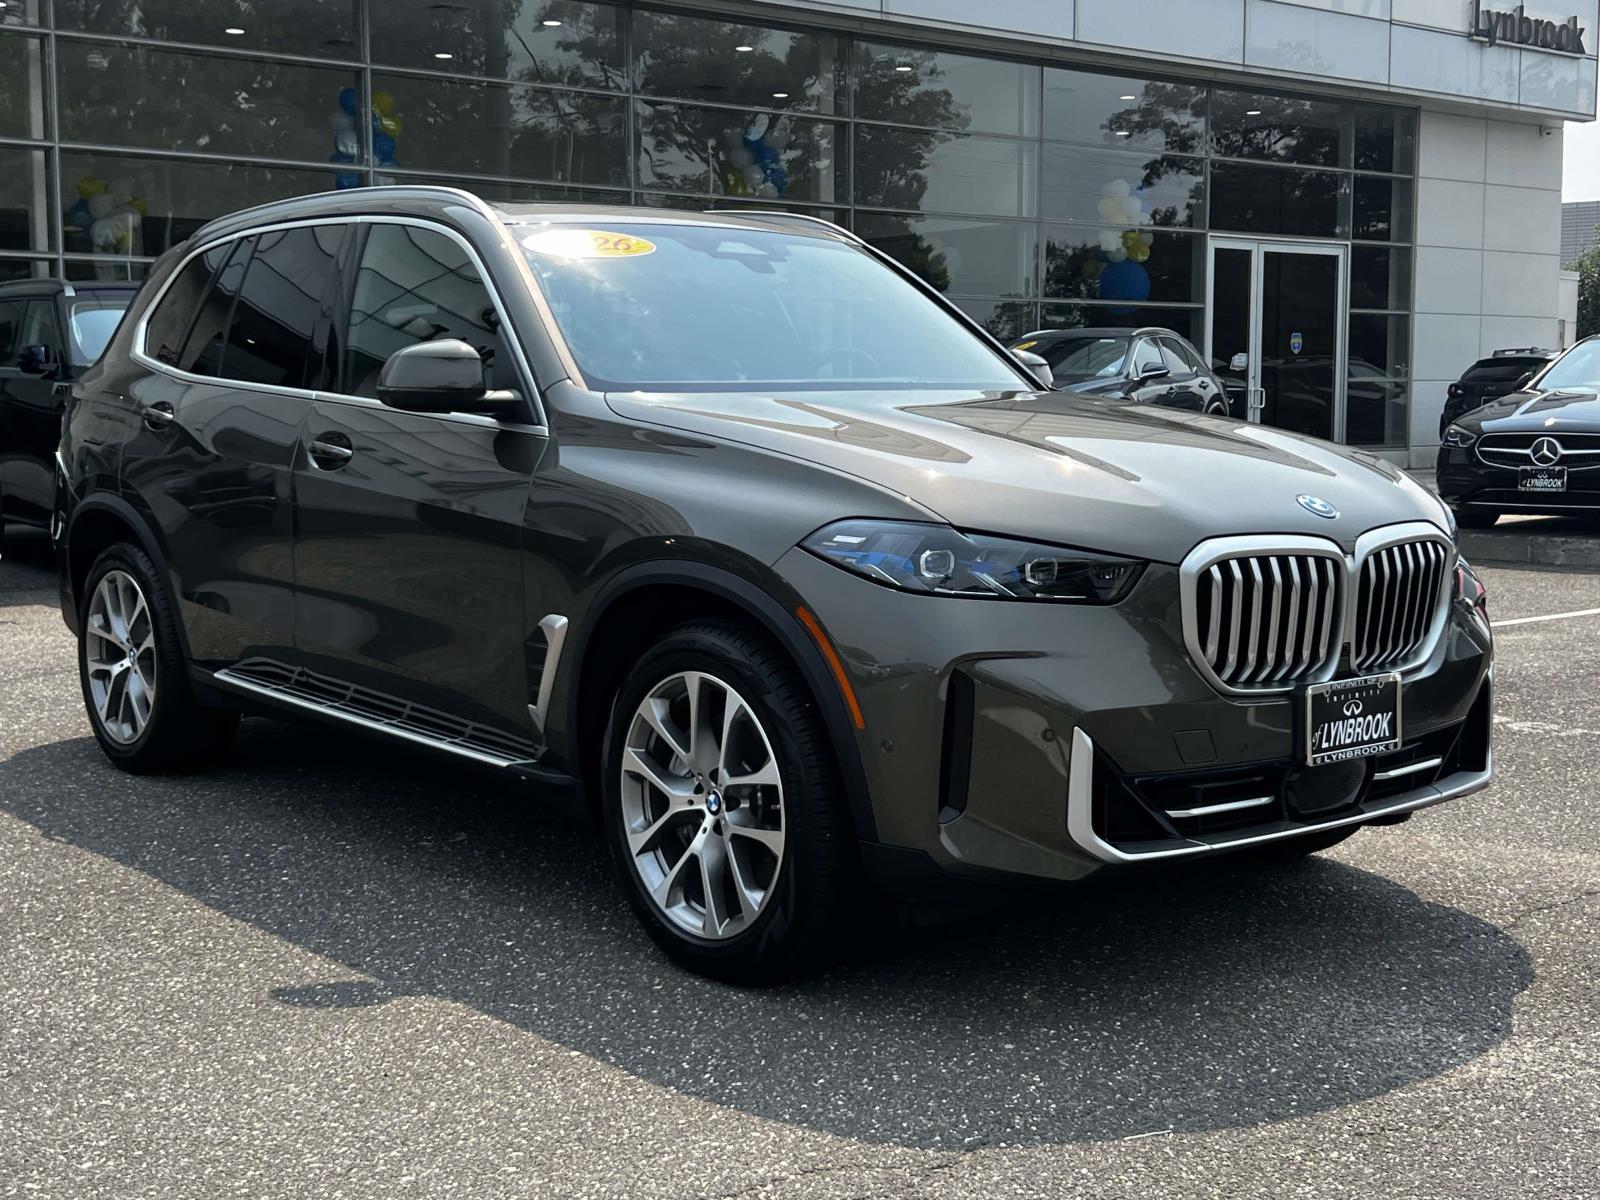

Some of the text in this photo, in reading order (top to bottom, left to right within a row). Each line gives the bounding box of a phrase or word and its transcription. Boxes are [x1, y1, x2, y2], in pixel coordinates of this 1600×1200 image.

[1470, 0, 1586, 54] Lynbrook
[1526, 479, 1563, 487] LYNBROOK
[1333, 680, 1365, 690] INFINITI
[1321, 712, 1393, 749] LYNBROOK
[1324, 744, 1387, 762] LYNBROOK
